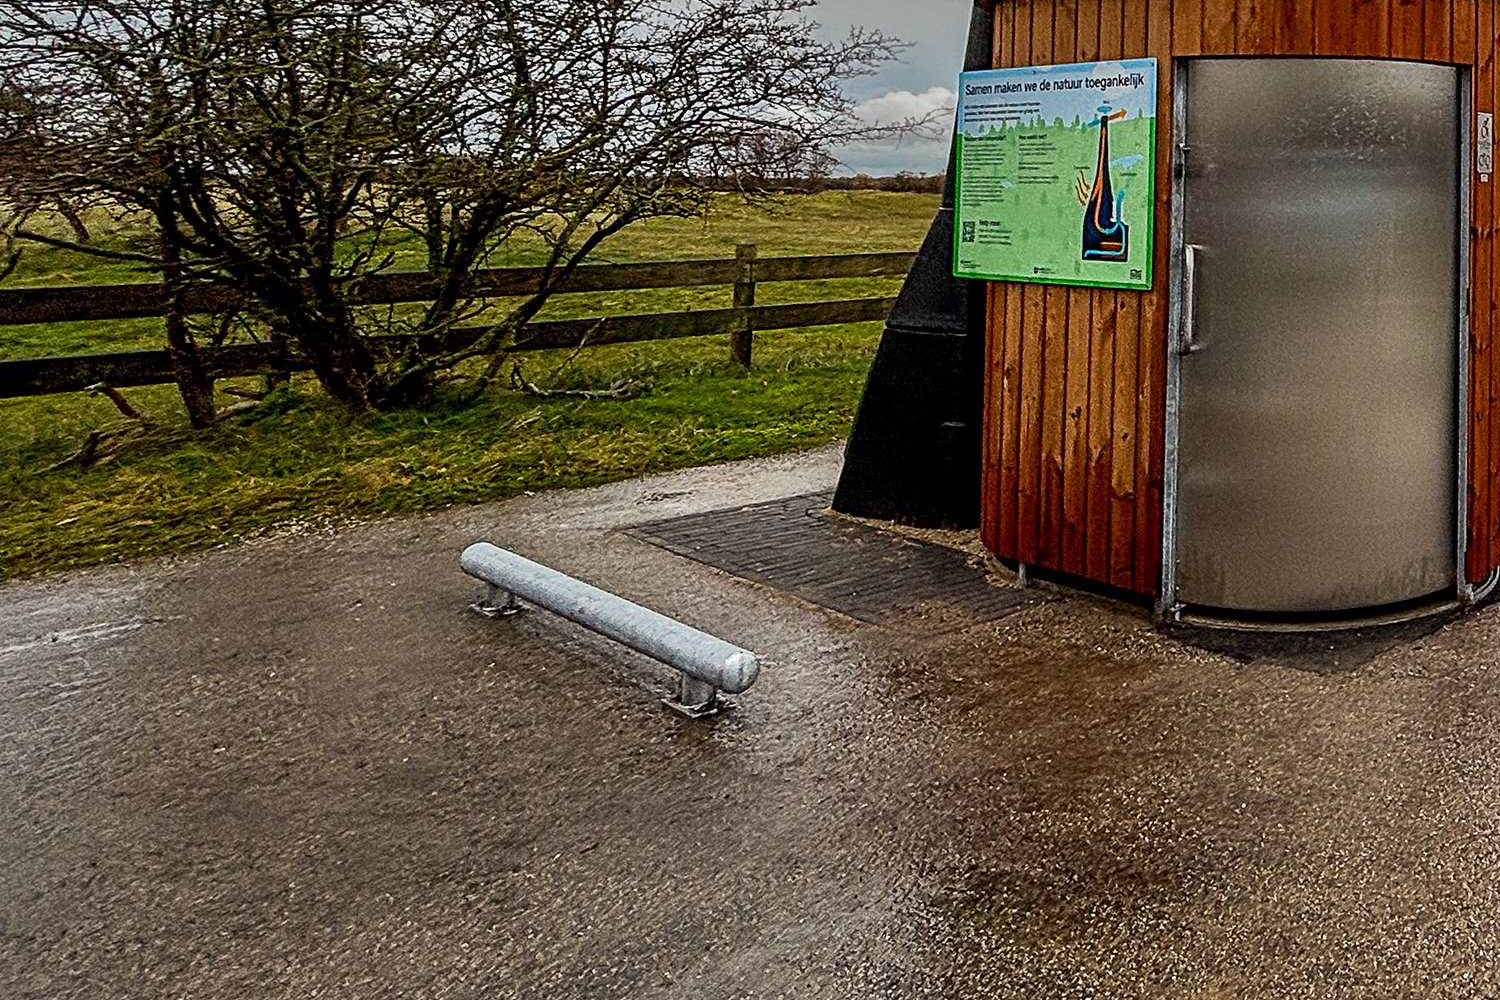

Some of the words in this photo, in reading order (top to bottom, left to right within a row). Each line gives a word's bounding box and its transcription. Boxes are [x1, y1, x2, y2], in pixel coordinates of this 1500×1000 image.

[965, 84, 992, 96] Samen
[994, 81, 1022, 94] maken
[1024, 82, 1037, 92] we
[1040, 79, 1051, 91] de
[1053, 77, 1083, 90] natuur
[1085, 73, 1145, 91] toegankelijk
